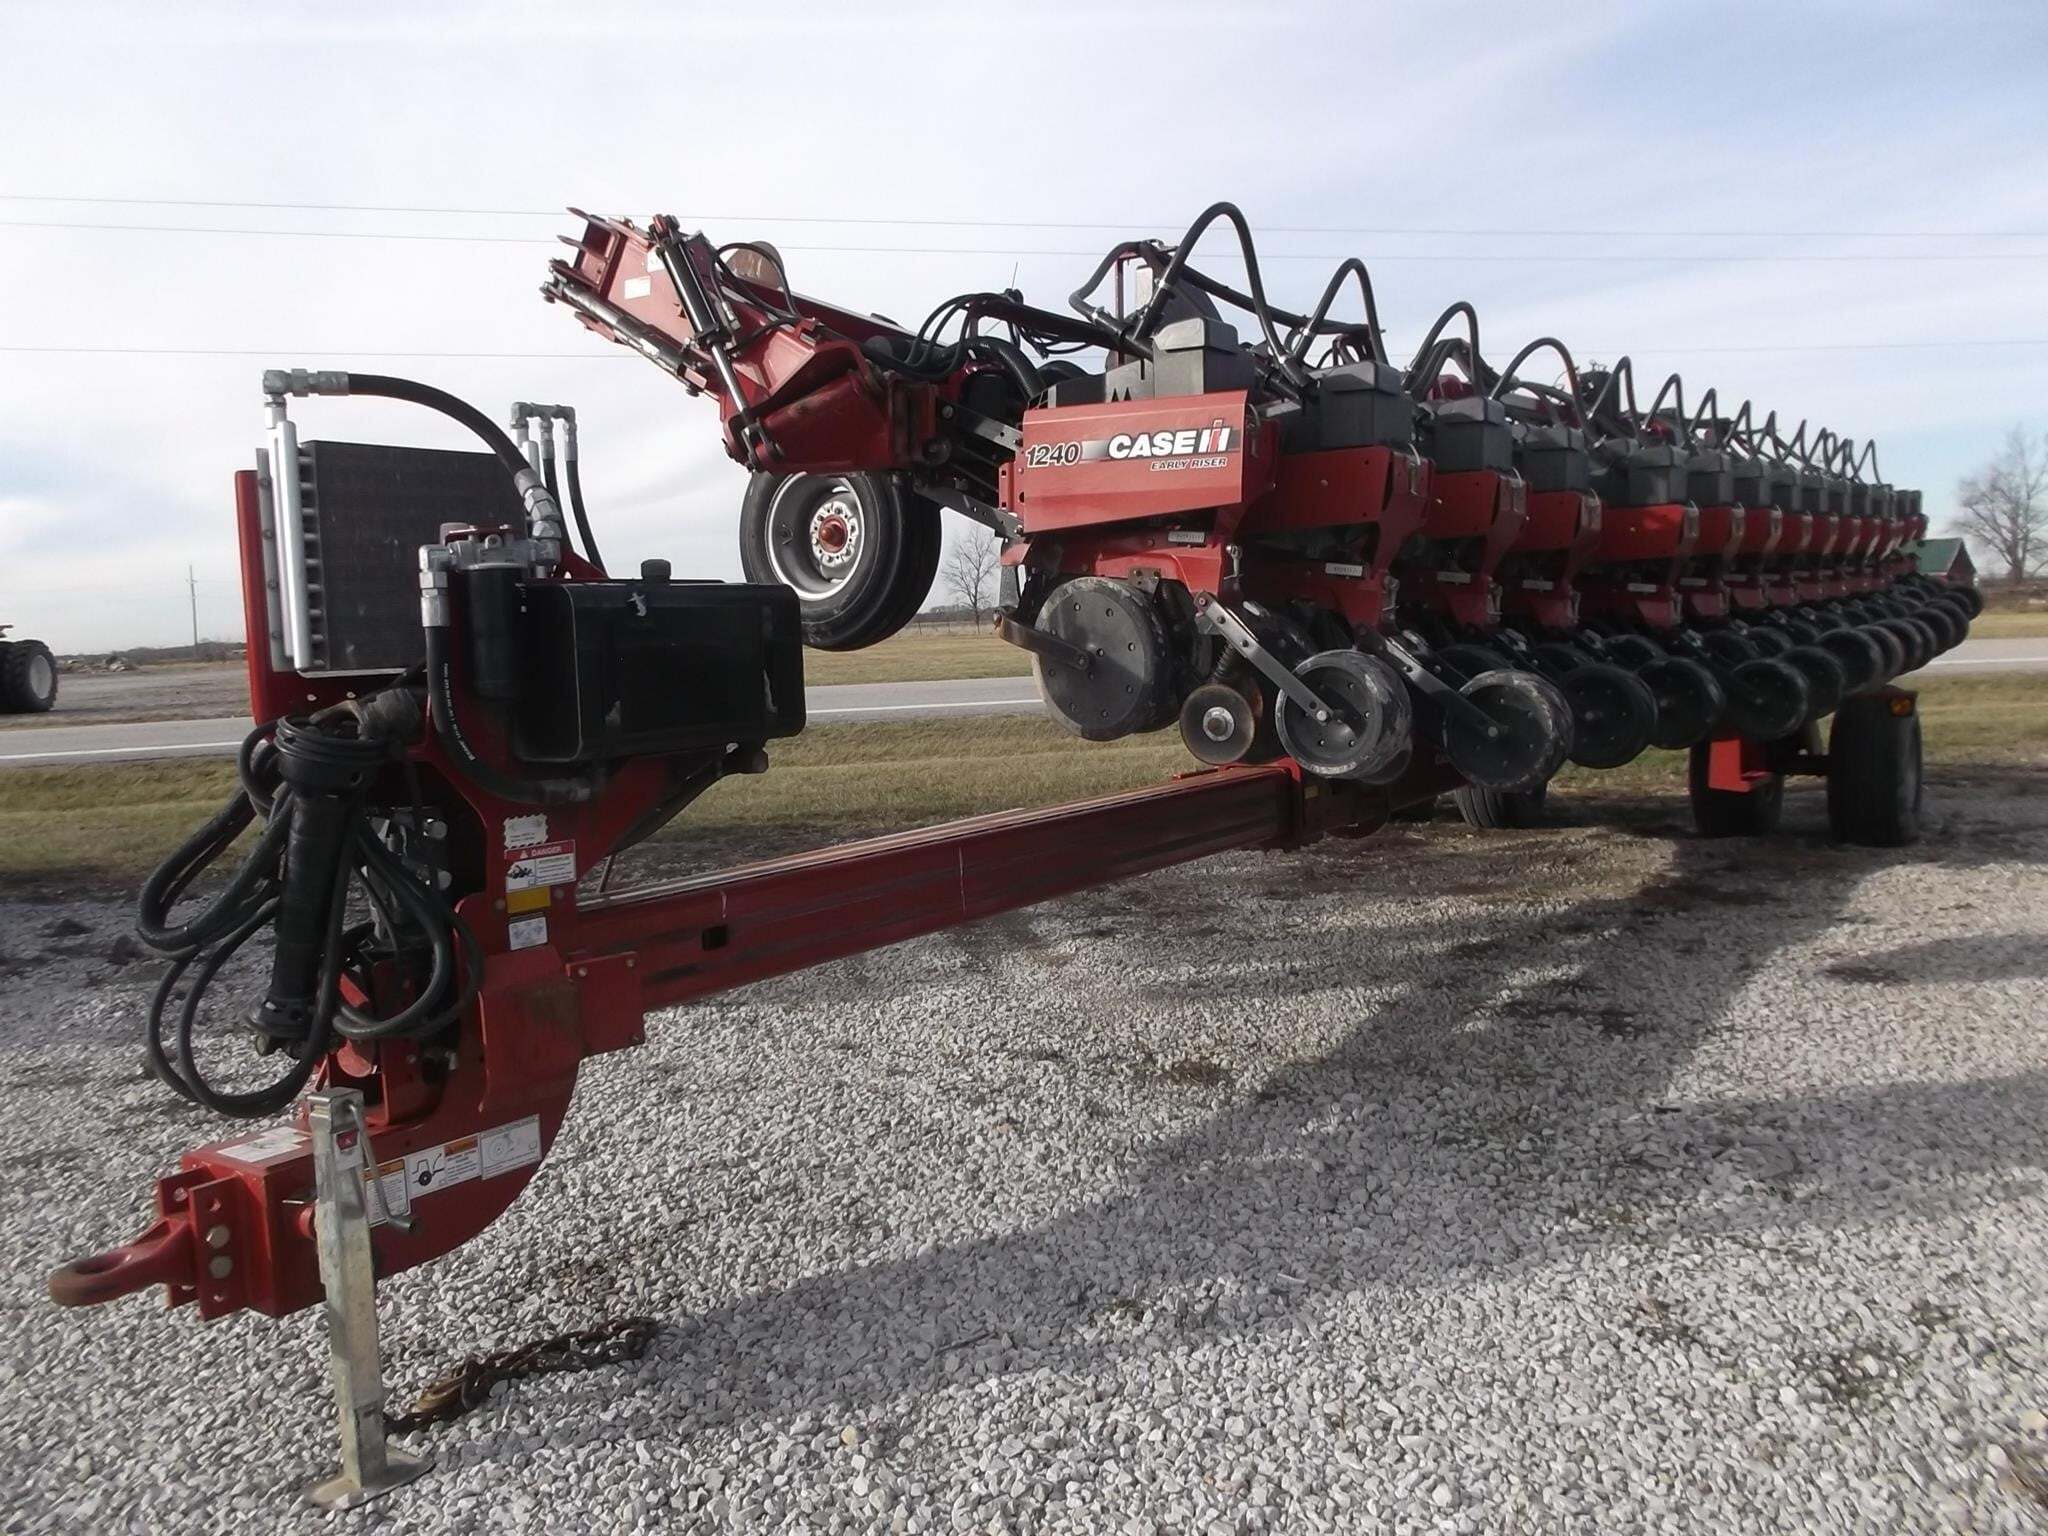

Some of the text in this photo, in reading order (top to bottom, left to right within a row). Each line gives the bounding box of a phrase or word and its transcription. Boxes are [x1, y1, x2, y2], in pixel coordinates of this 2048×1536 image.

[1026, 441, 1081, 467] 1240
[1151, 457, 1227, 471] EARLY RISER
[531, 846, 562, 857] DANGER
